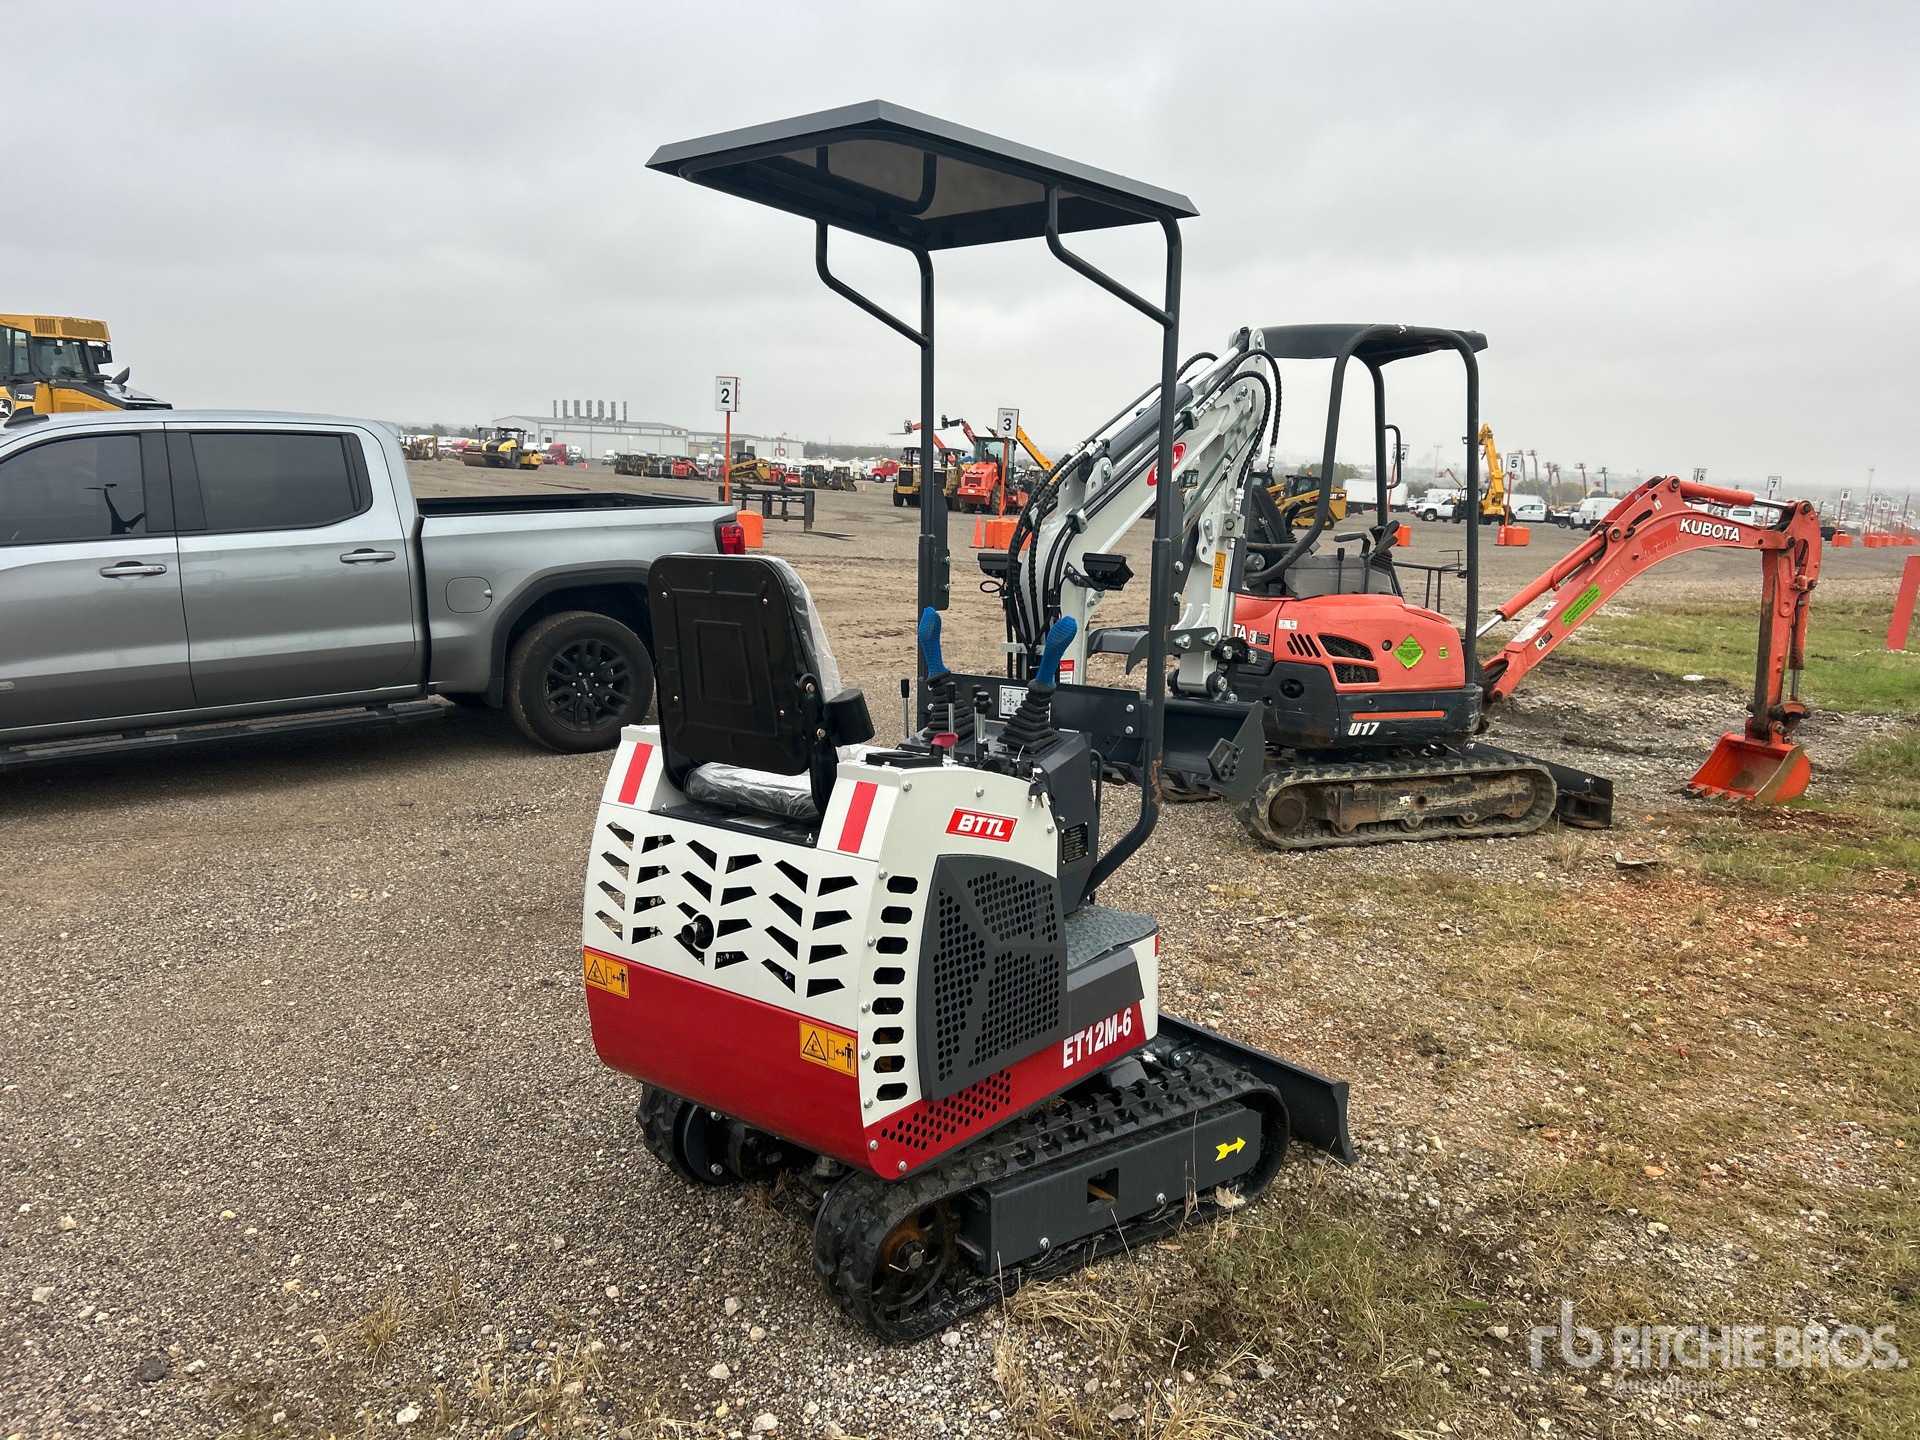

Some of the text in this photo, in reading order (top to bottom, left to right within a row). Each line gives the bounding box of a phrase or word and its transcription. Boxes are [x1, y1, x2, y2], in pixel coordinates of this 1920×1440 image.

[721, 388, 730, 403] 2
[1003, 418, 1012, 431] 3
[1510, 459, 1518, 469] 5
[1679, 518, 1741, 542] KUBOTA
[1347, 721, 1380, 736] U17
[957, 813, 1006, 837] BTTL
[1063, 1007, 1132, 1069] ET12M-6
